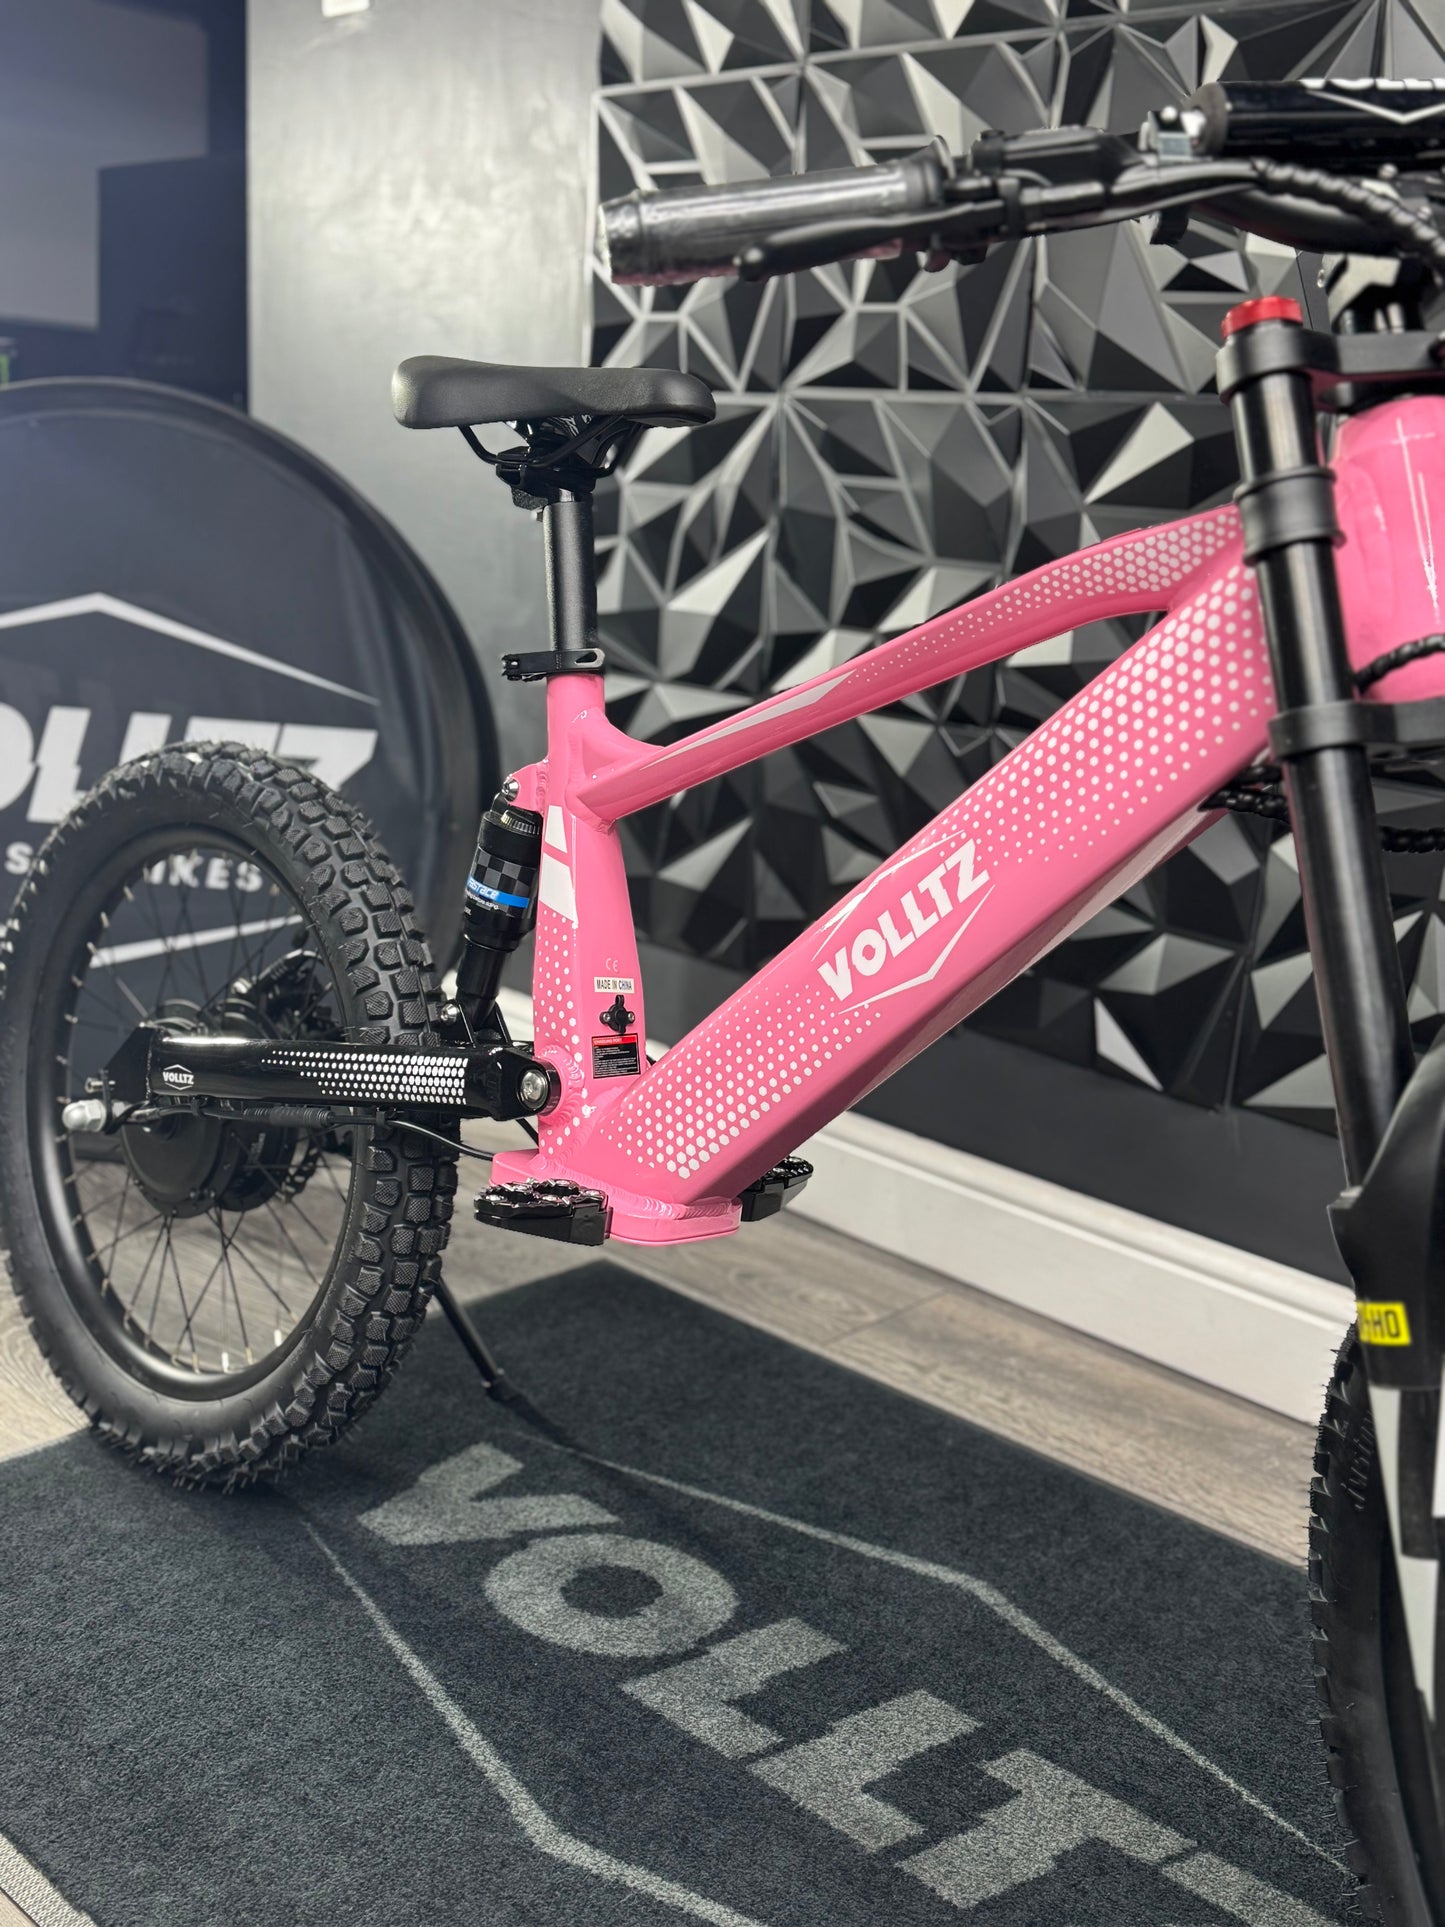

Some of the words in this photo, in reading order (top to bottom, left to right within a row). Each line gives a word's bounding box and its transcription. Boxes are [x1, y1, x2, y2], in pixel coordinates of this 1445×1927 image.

[817, 838, 990, 1002] VOLLTZ
[605, 957, 619, 973] CE
[596, 978, 611, 990] MADE
[612, 979, 618, 990] IN
[618, 979, 633, 991] CHINA
[162, 1071, 194, 1085] VOLLTZ
